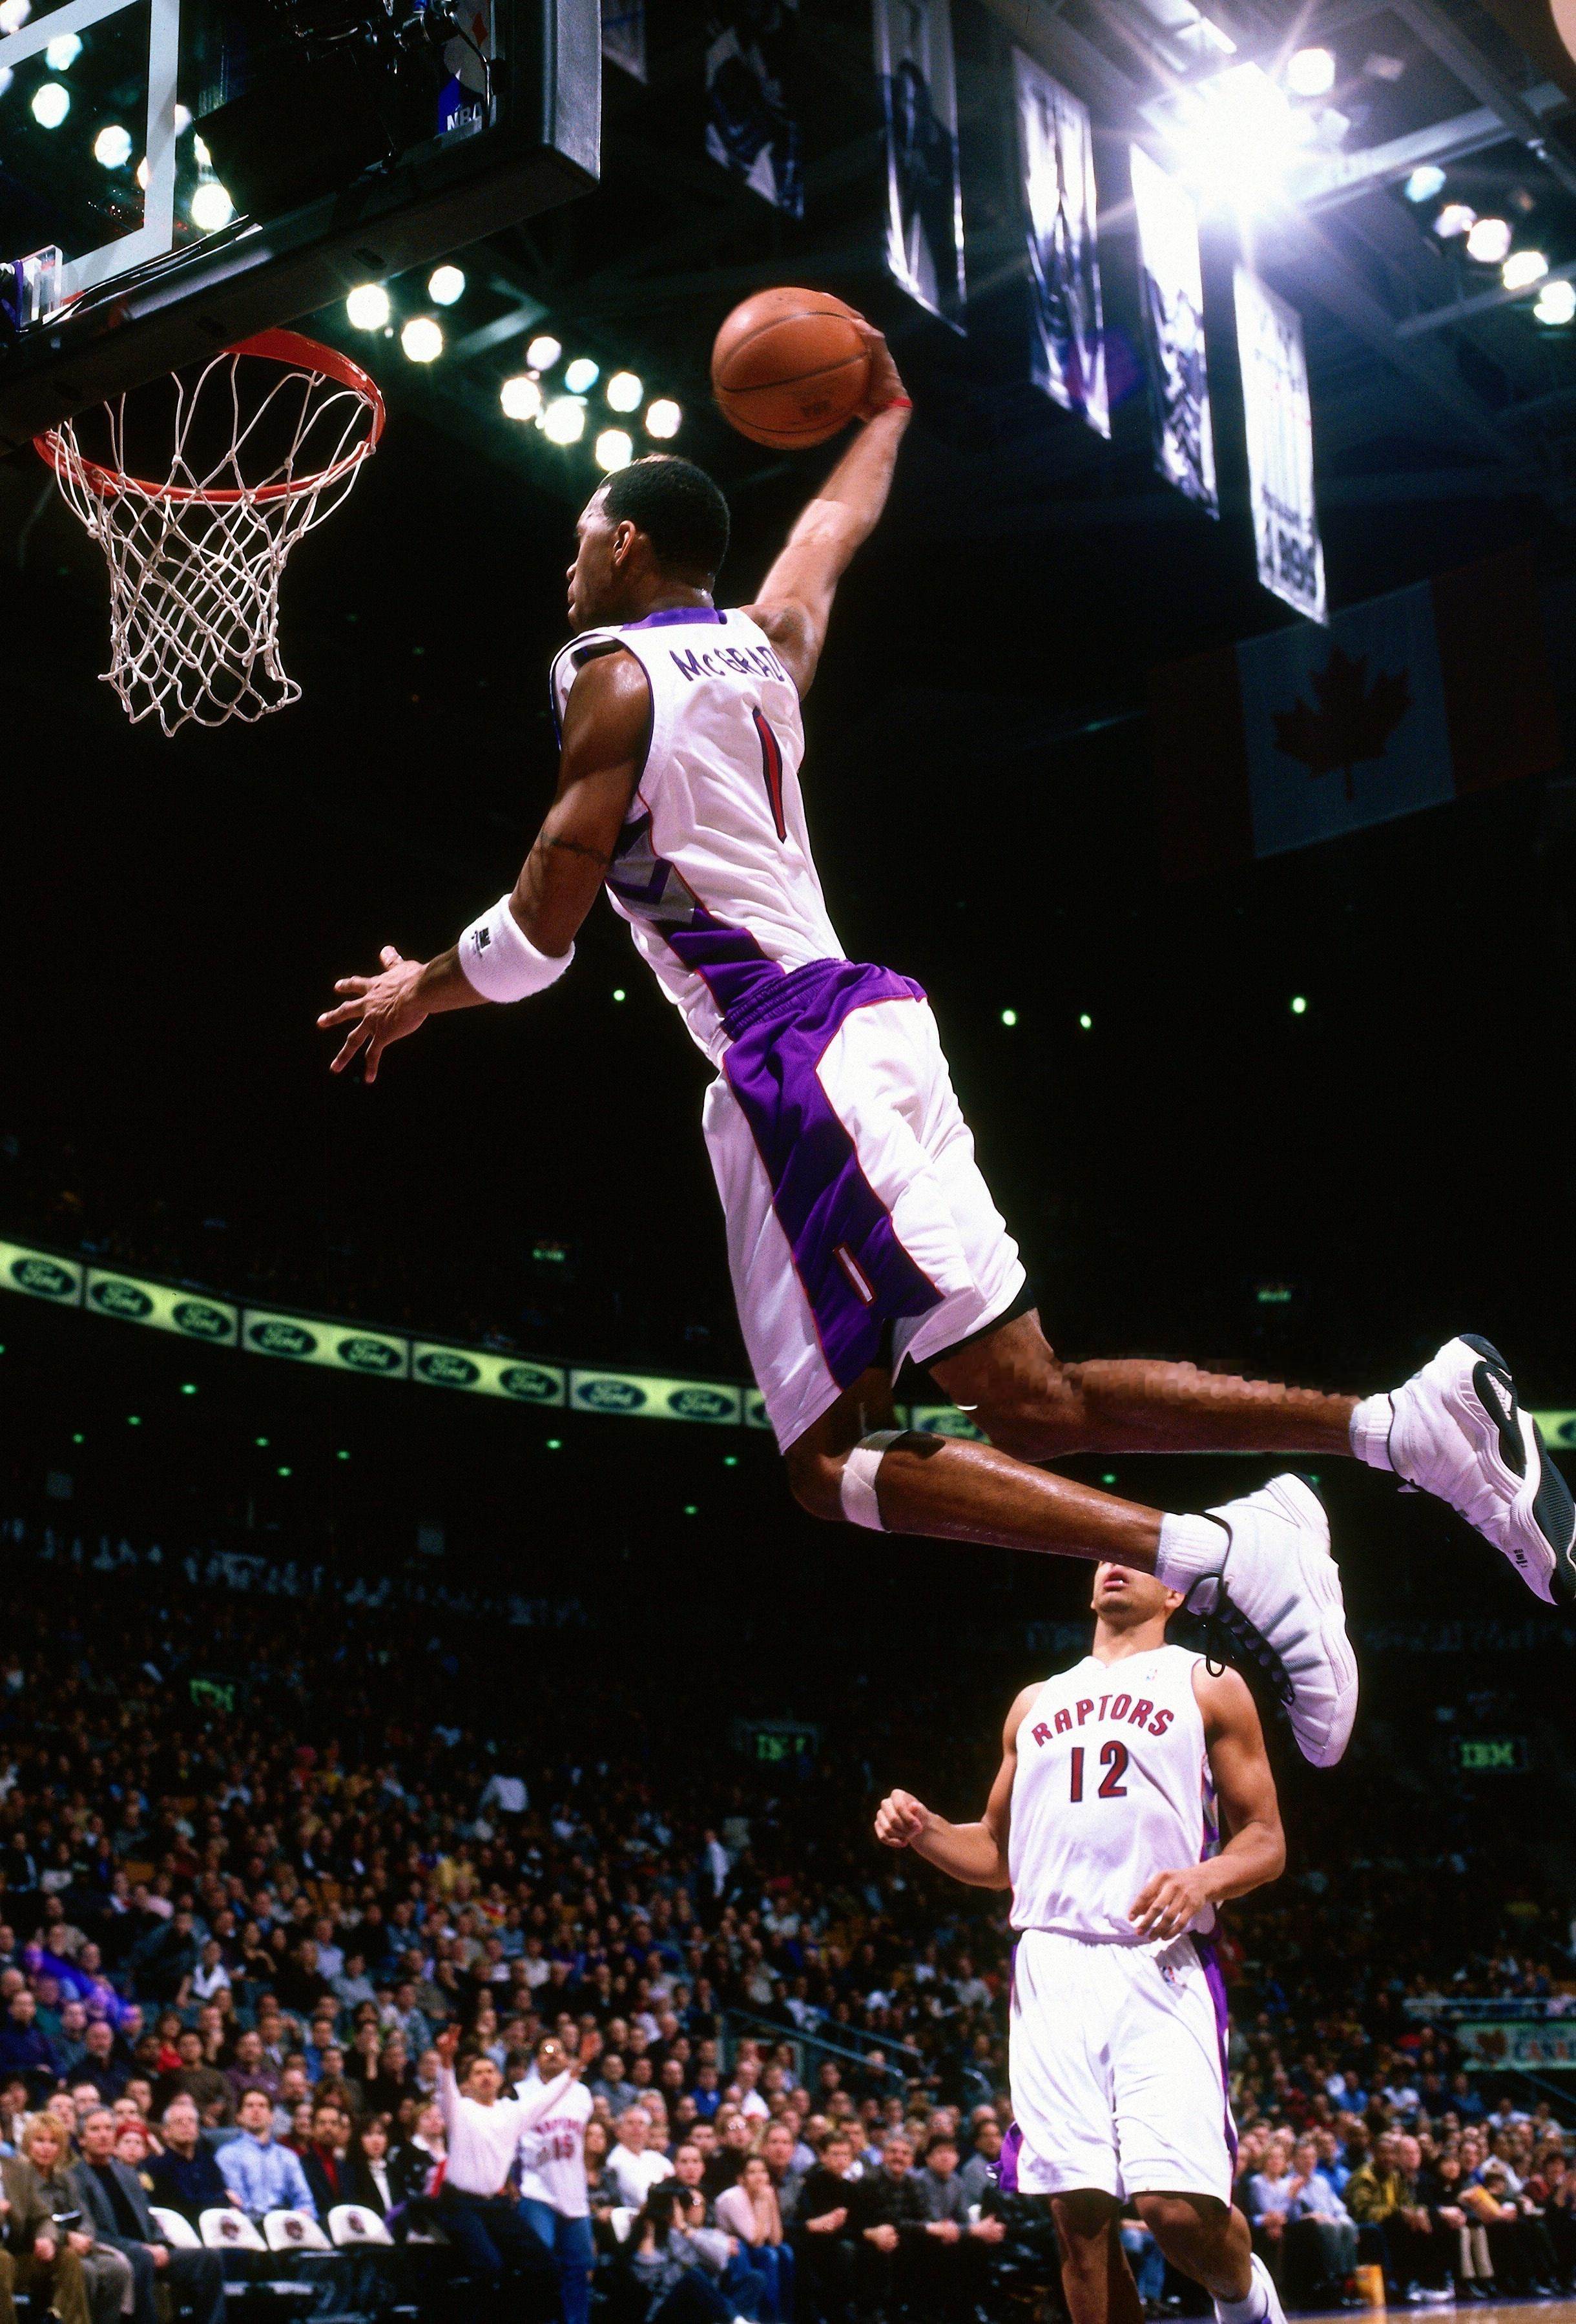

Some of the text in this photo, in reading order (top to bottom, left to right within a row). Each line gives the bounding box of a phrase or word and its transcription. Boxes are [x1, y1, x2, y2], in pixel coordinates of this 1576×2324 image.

[752, 706, 787, 844] 1
[1032, 1694, 1174, 1747] RAPTORS
[1070, 1740, 1129, 1803] 12
